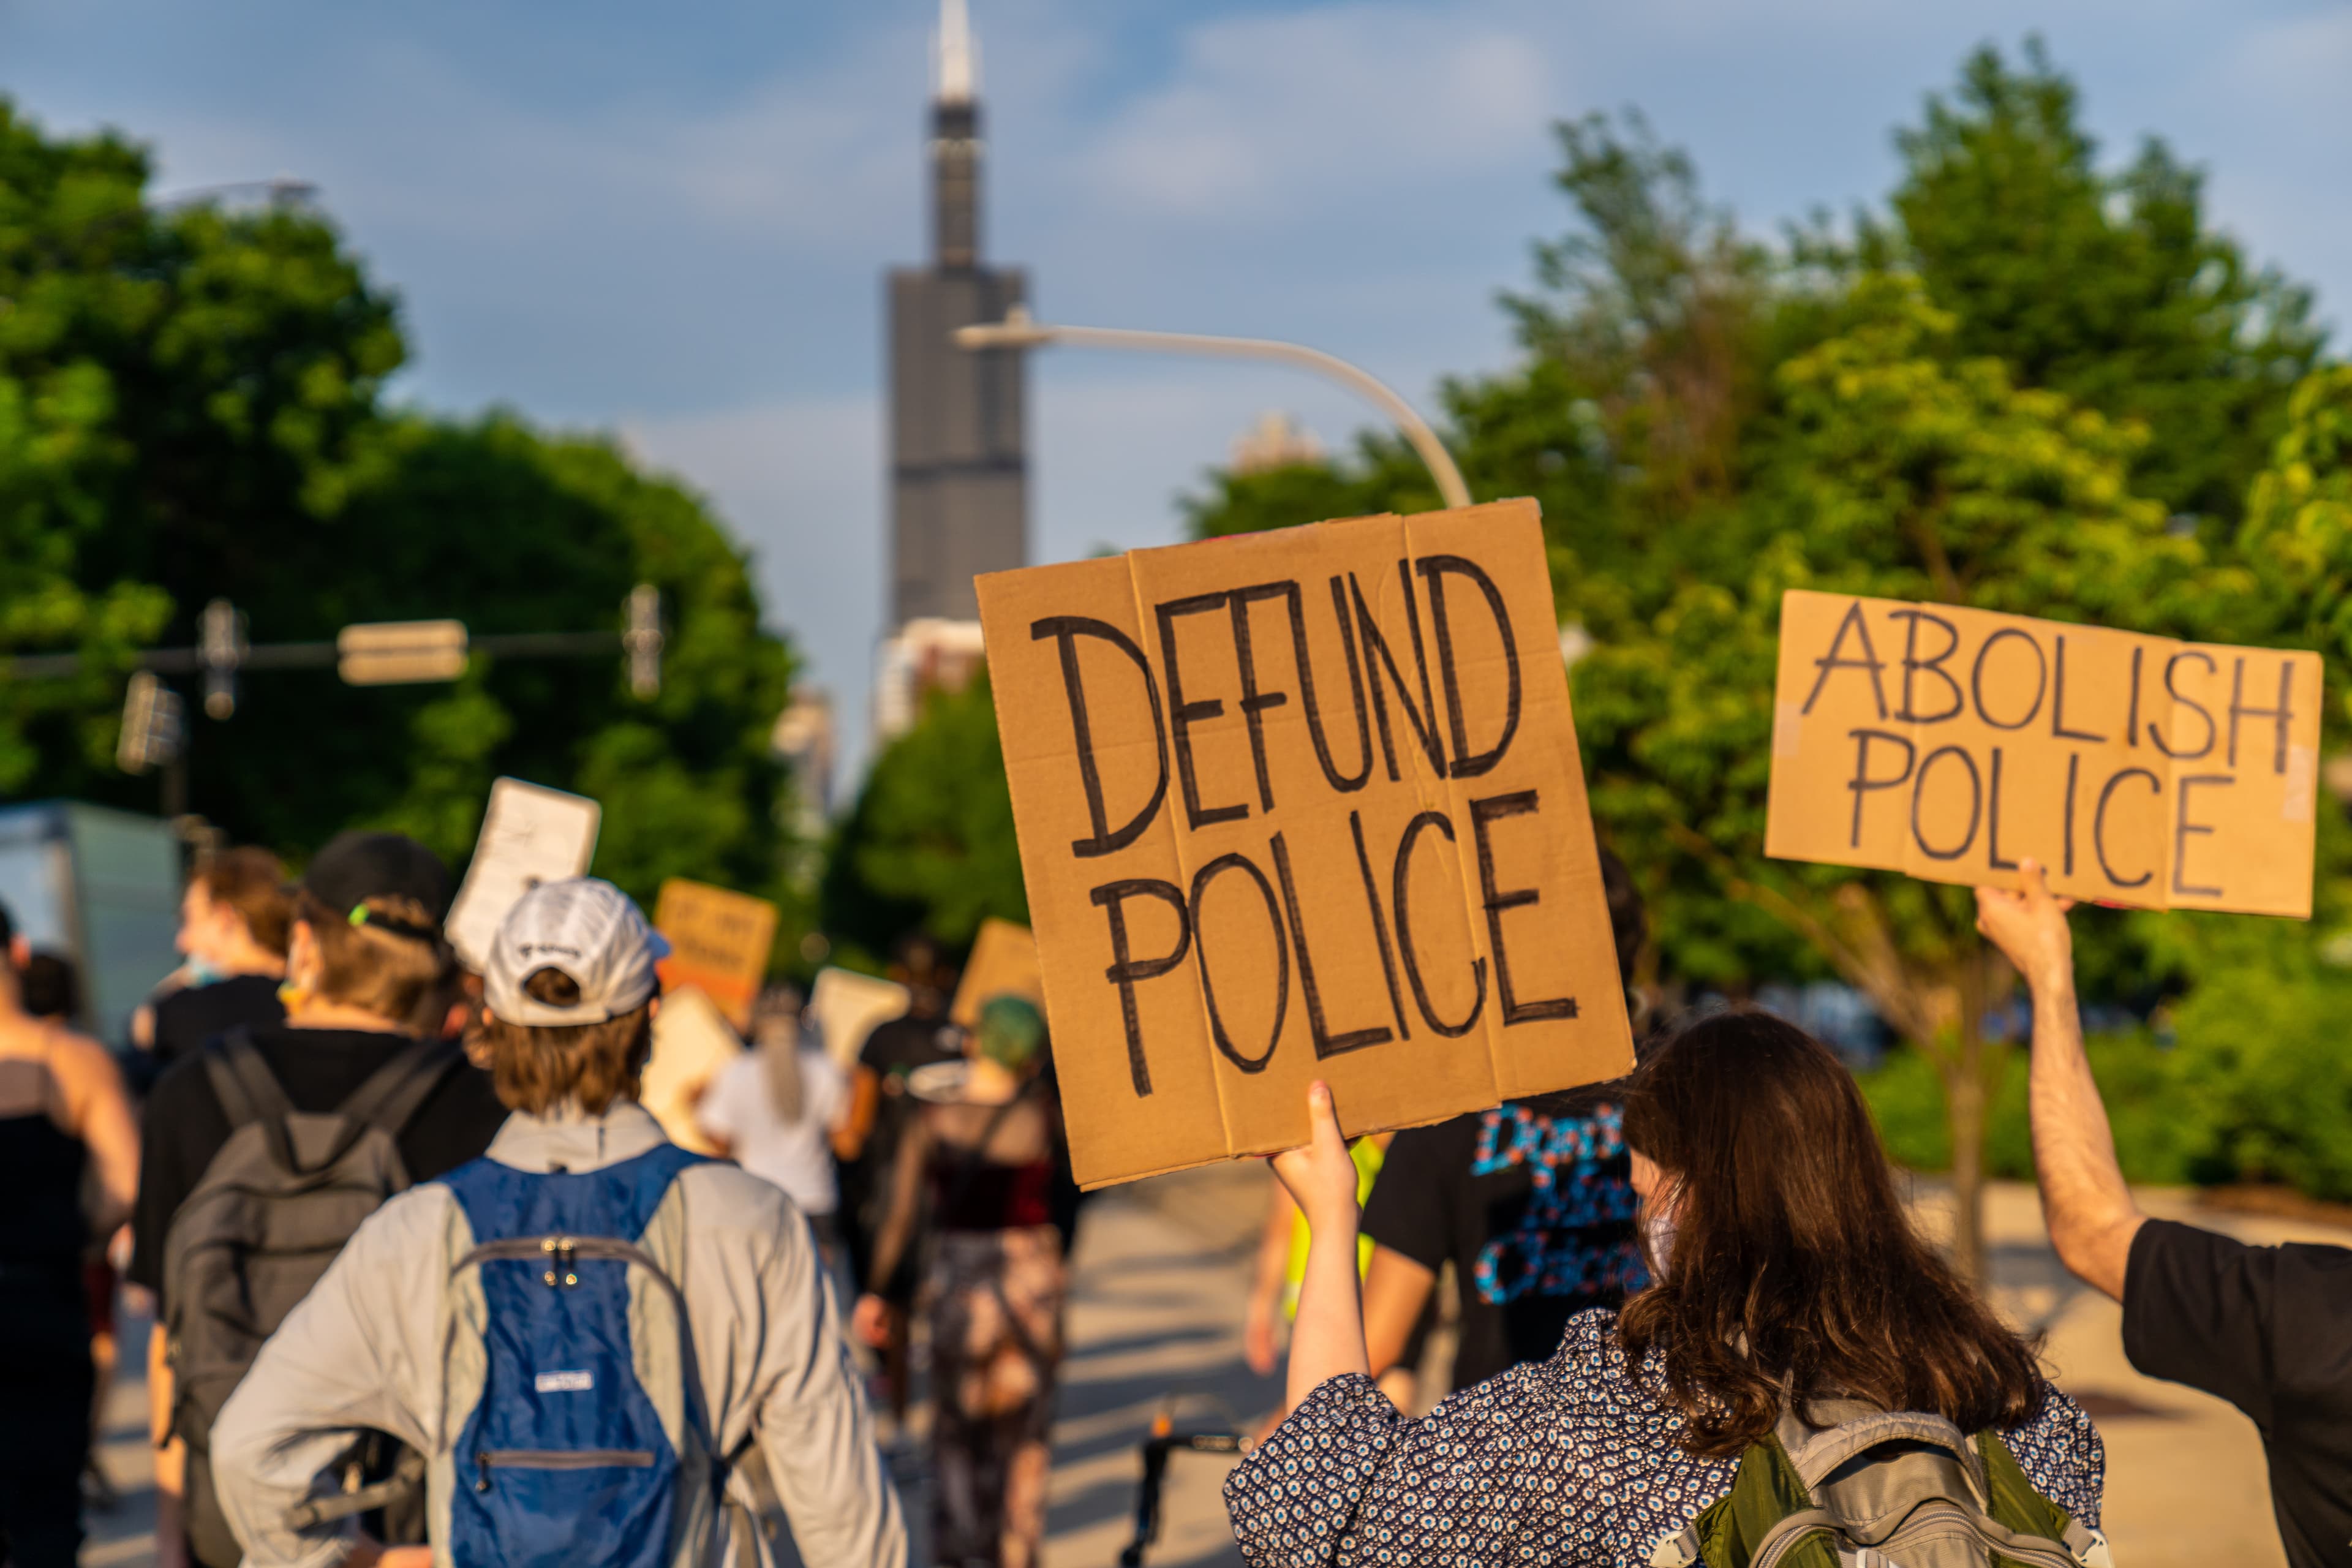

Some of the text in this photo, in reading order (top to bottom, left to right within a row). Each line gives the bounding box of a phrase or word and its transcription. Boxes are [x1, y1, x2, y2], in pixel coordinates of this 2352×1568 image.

[1031, 556, 1521, 857] DEFUND
[1801, 600, 2295, 774] ABOLISH
[1848, 729, 2236, 897] POLICE
[1090, 790, 1579, 1098] POLICE
